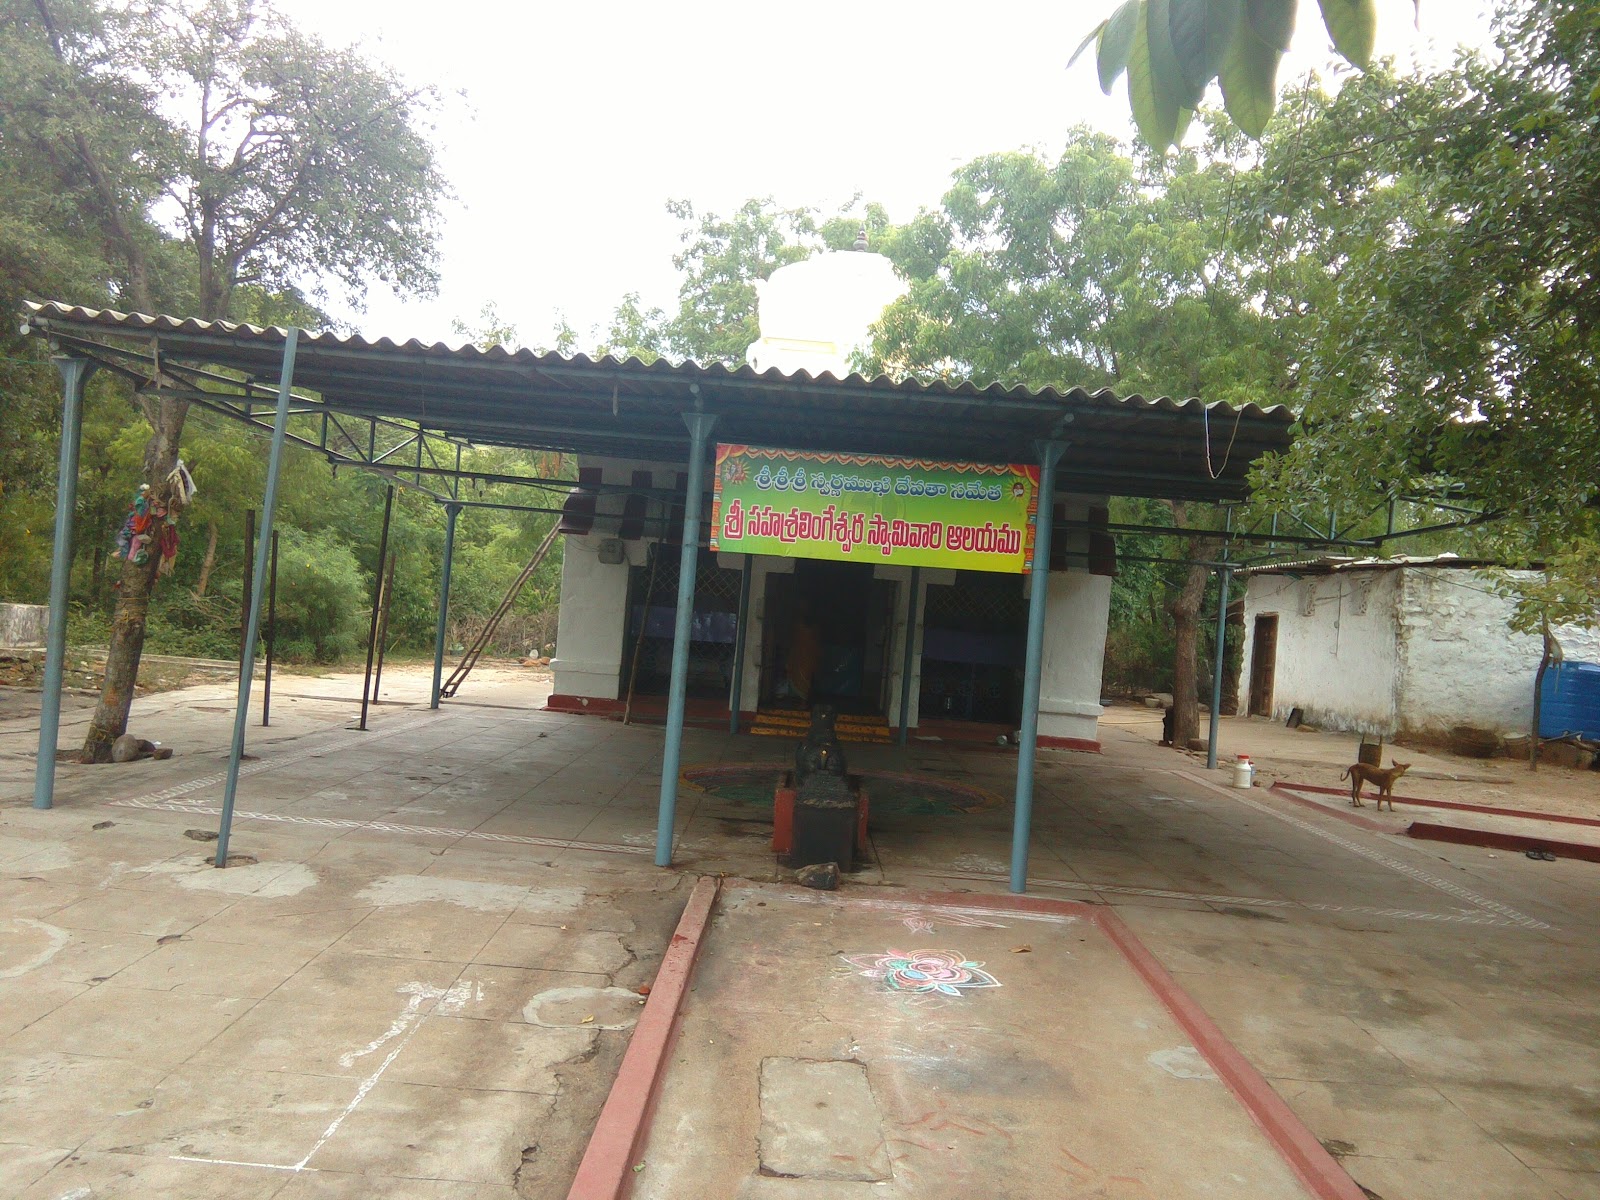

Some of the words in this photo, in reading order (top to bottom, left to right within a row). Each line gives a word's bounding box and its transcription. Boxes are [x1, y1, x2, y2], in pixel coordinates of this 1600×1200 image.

[895, 475, 948, 498] దేవతా
[950, 481, 1002, 502] సమేత
[724, 499, 744, 540] శ్రీ
[867, 513, 943, 556] స్వామివారి
[946, 521, 1021, 555] ఆలయము
